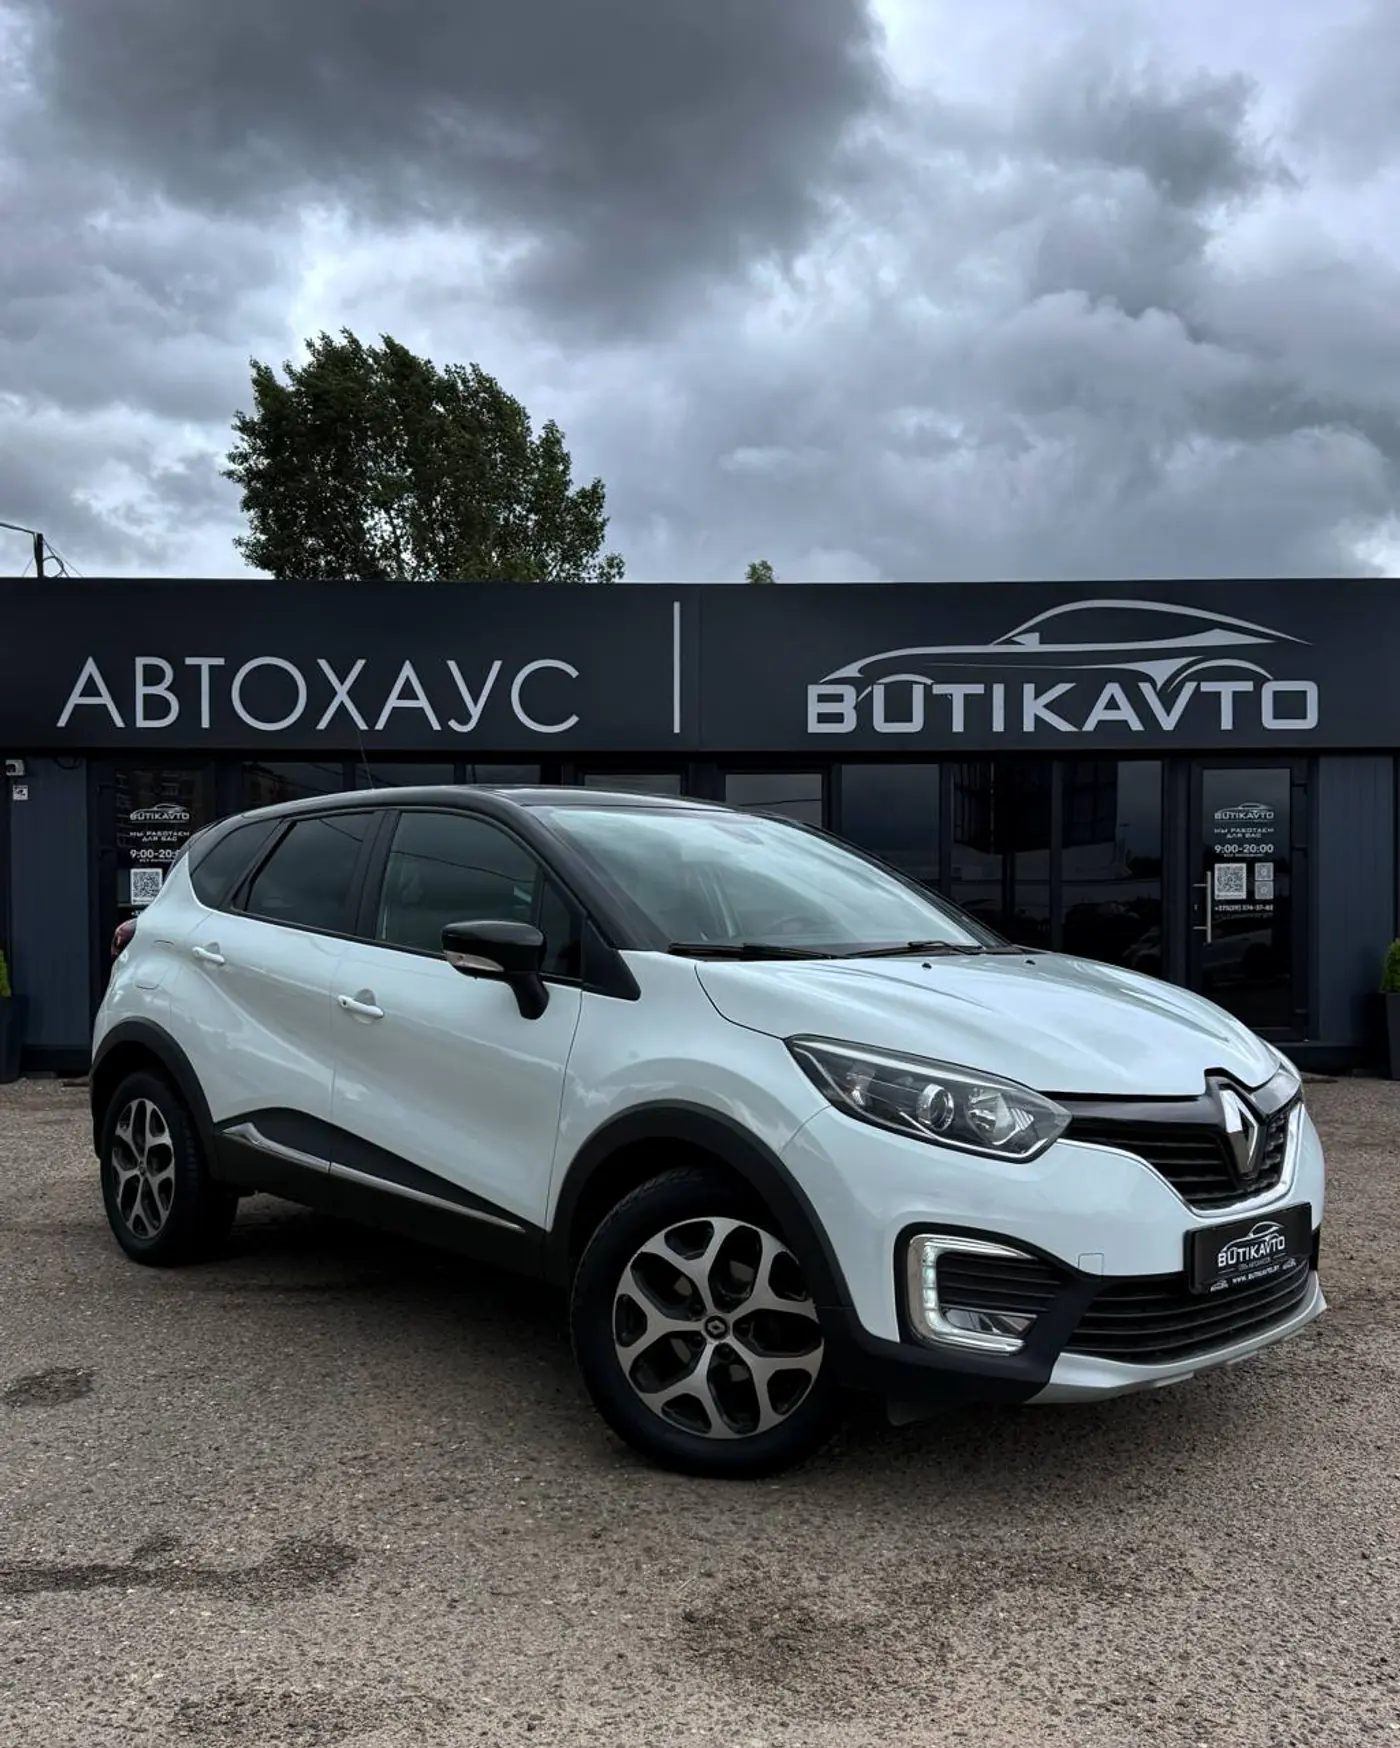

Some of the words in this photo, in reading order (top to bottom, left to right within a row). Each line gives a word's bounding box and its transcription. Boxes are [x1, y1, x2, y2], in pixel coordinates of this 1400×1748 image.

[57, 656, 580, 733] АВТОХАУС
[807, 680, 1319, 734] BUTIKAVTO
[129, 812, 190, 820] BUTIKAVTO
[1214, 811, 1274, 819] BUTIKAVTO
[1214, 844, 1274, 853] 9:00-20:00
[1217, 1236, 1285, 1267] BUTIKAVTO
